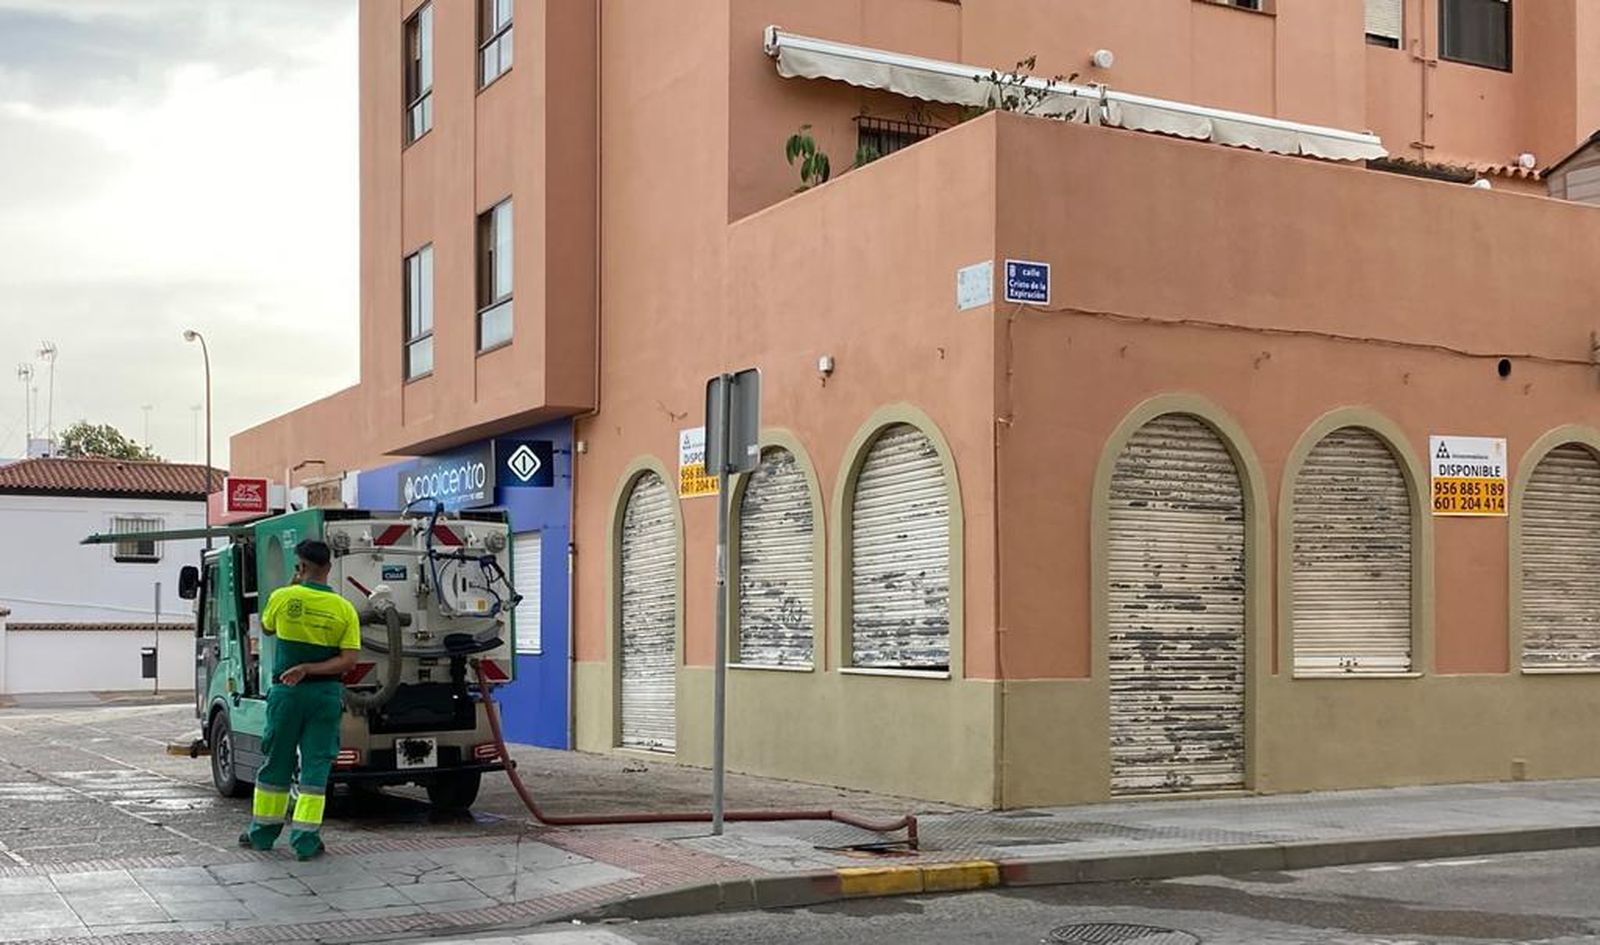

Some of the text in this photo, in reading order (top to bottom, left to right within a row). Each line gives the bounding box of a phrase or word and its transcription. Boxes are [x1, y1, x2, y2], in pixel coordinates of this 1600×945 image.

[1022, 268, 1040, 277] calle
[1009, 279, 1046, 290] Cristo de la
[1009, 288, 1045, 299] Expiración
[684, 450, 704, 464] DISPO
[1439, 464, 1501, 477] DISPONIBLE
[1434, 481, 1504, 496] 956 885 189
[1434, 497, 1505, 511] 601 204 414
